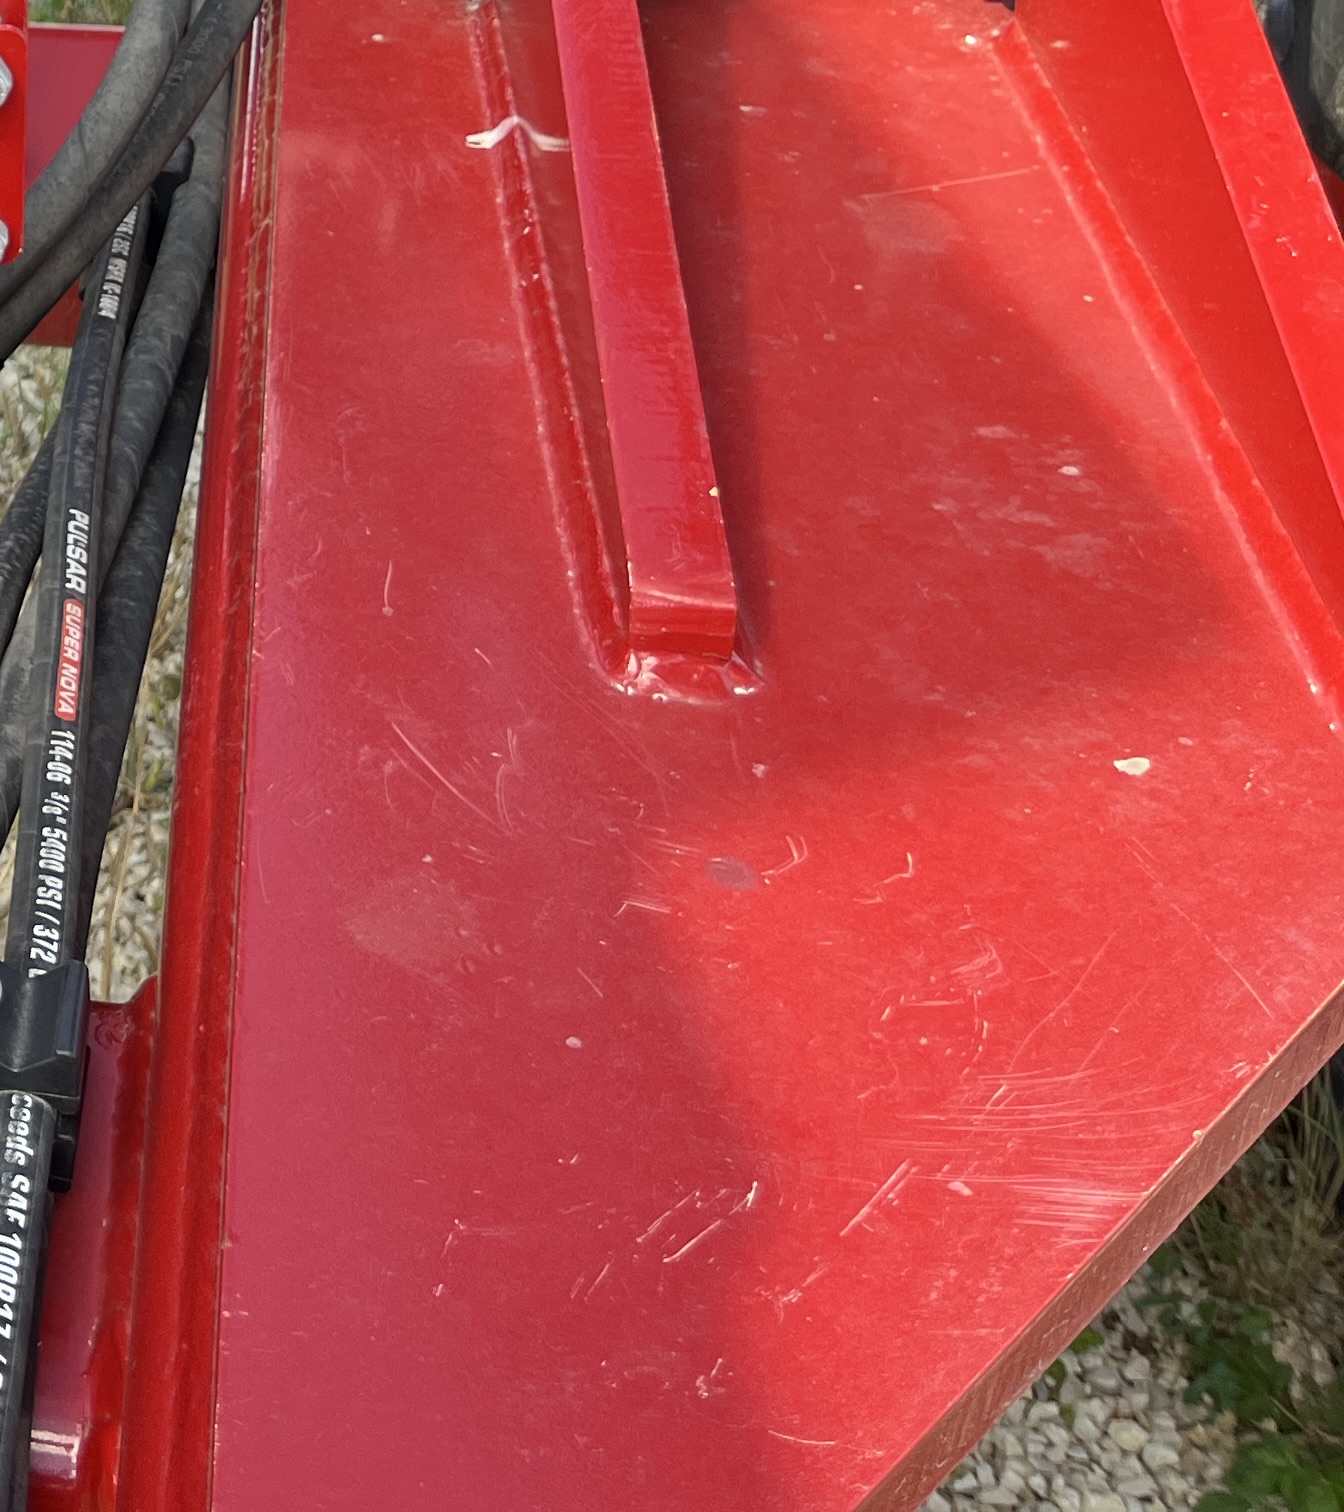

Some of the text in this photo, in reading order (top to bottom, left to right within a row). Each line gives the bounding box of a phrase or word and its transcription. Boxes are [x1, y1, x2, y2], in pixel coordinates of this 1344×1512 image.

[64, 508, 90, 595] PULSAR
[62, 602, 82, 662] SUPER
[57, 662, 81, 715] NOVA
[45, 729, 76, 786] 114-06
[38, 826, 68, 873] 5400
[35, 874, 64, 910] PSI
[29, 924, 60, 964] 372
[0, 1170, 31, 1229] SAE
